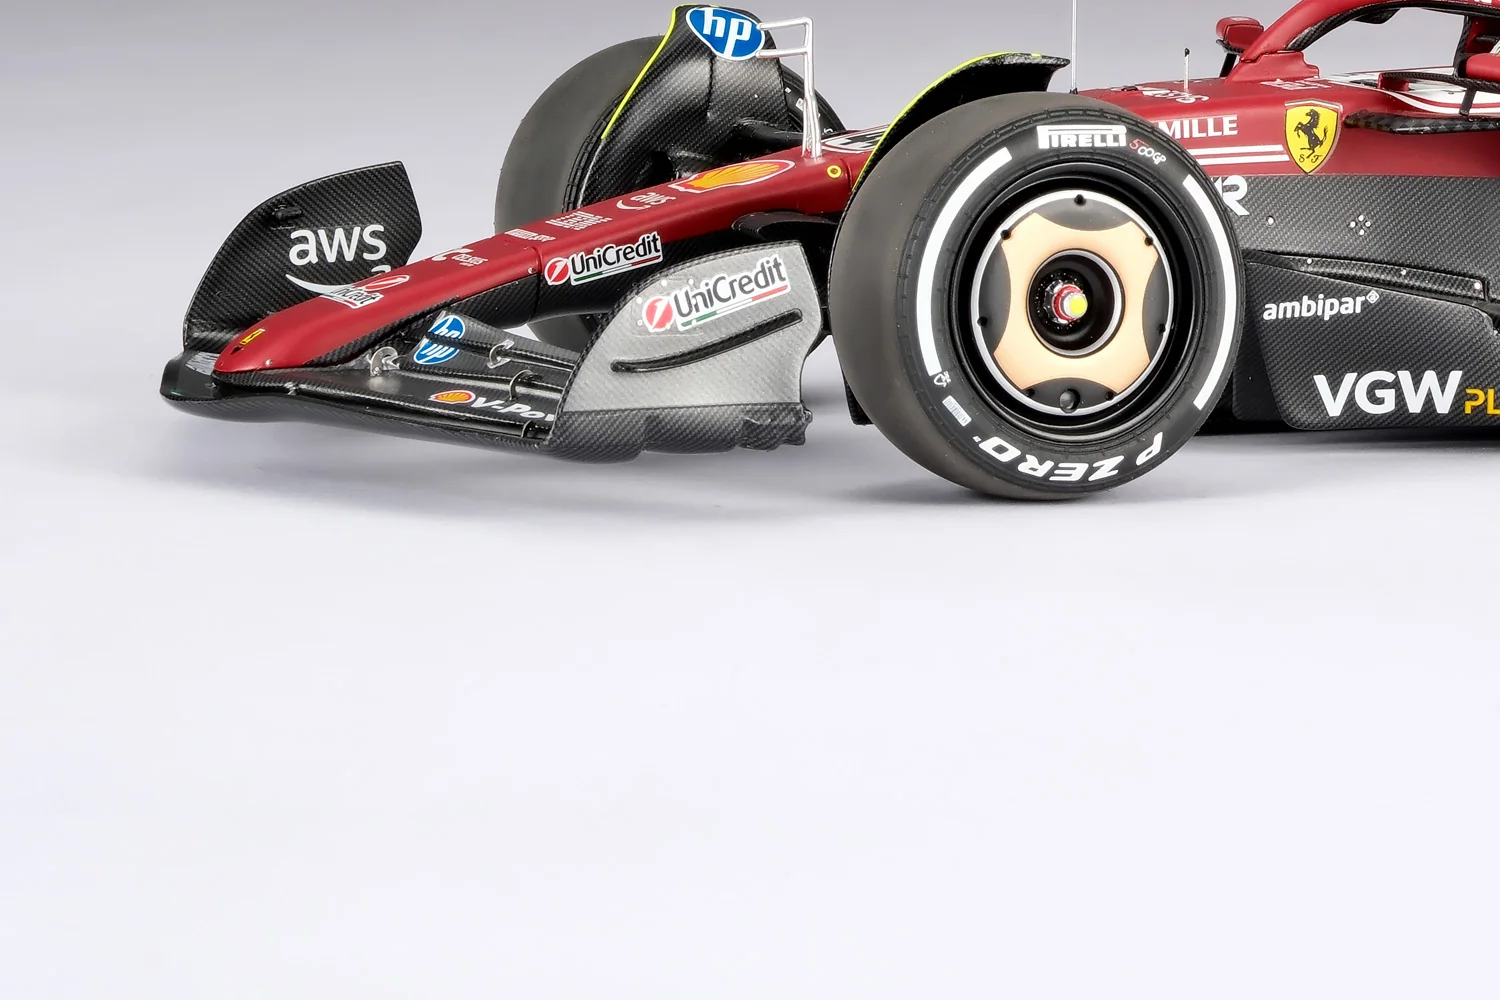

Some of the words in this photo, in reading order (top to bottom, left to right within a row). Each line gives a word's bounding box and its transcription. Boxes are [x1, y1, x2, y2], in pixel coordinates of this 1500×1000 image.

[702, 7, 752, 58] hp
[1037, 125, 1127, 149] PIRELLI
[289, 224, 387, 266] aws
[571, 232, 661, 276] UniCredit
[673, 256, 787, 318] UniCredit
[1262, 293, 1366, 321] ambipar
[1313, 370, 1463, 417] VGW
[978, 436, 1125, 482] ZERO
[1136, 431, 1164, 466] P
